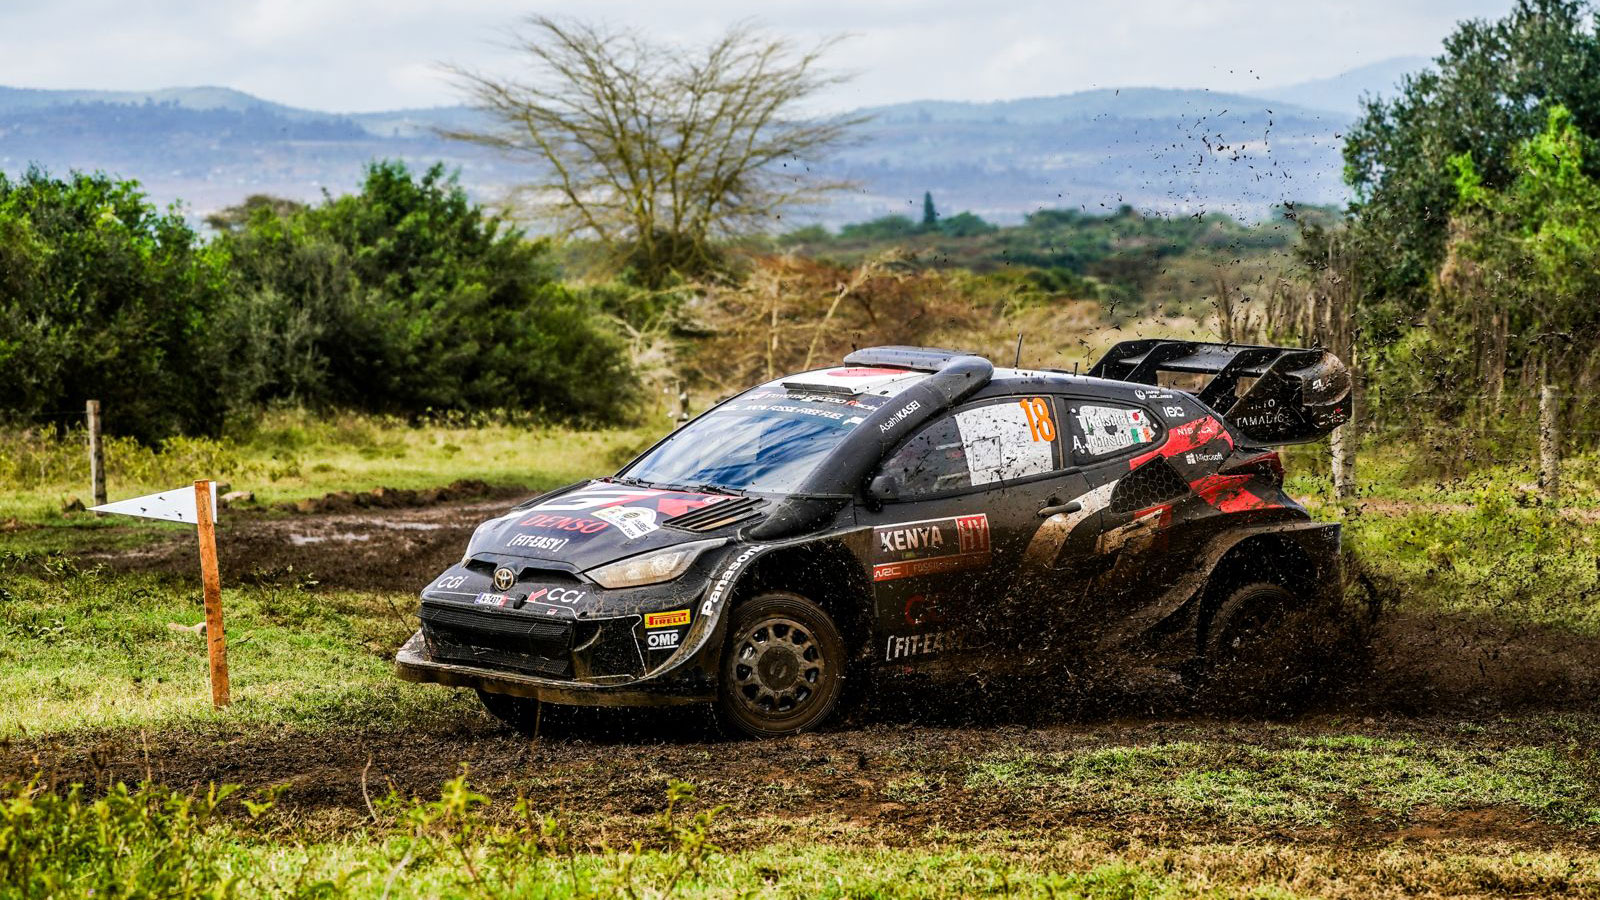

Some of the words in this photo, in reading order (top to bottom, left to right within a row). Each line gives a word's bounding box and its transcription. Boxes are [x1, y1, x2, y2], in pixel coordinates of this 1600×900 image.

[1019, 397, 1056, 442] 18
[520, 515, 609, 534] DENSO
[880, 525, 944, 552] KENYA
[648, 612, 688, 625] PIRELLI
[647, 632, 679, 647] OMP
